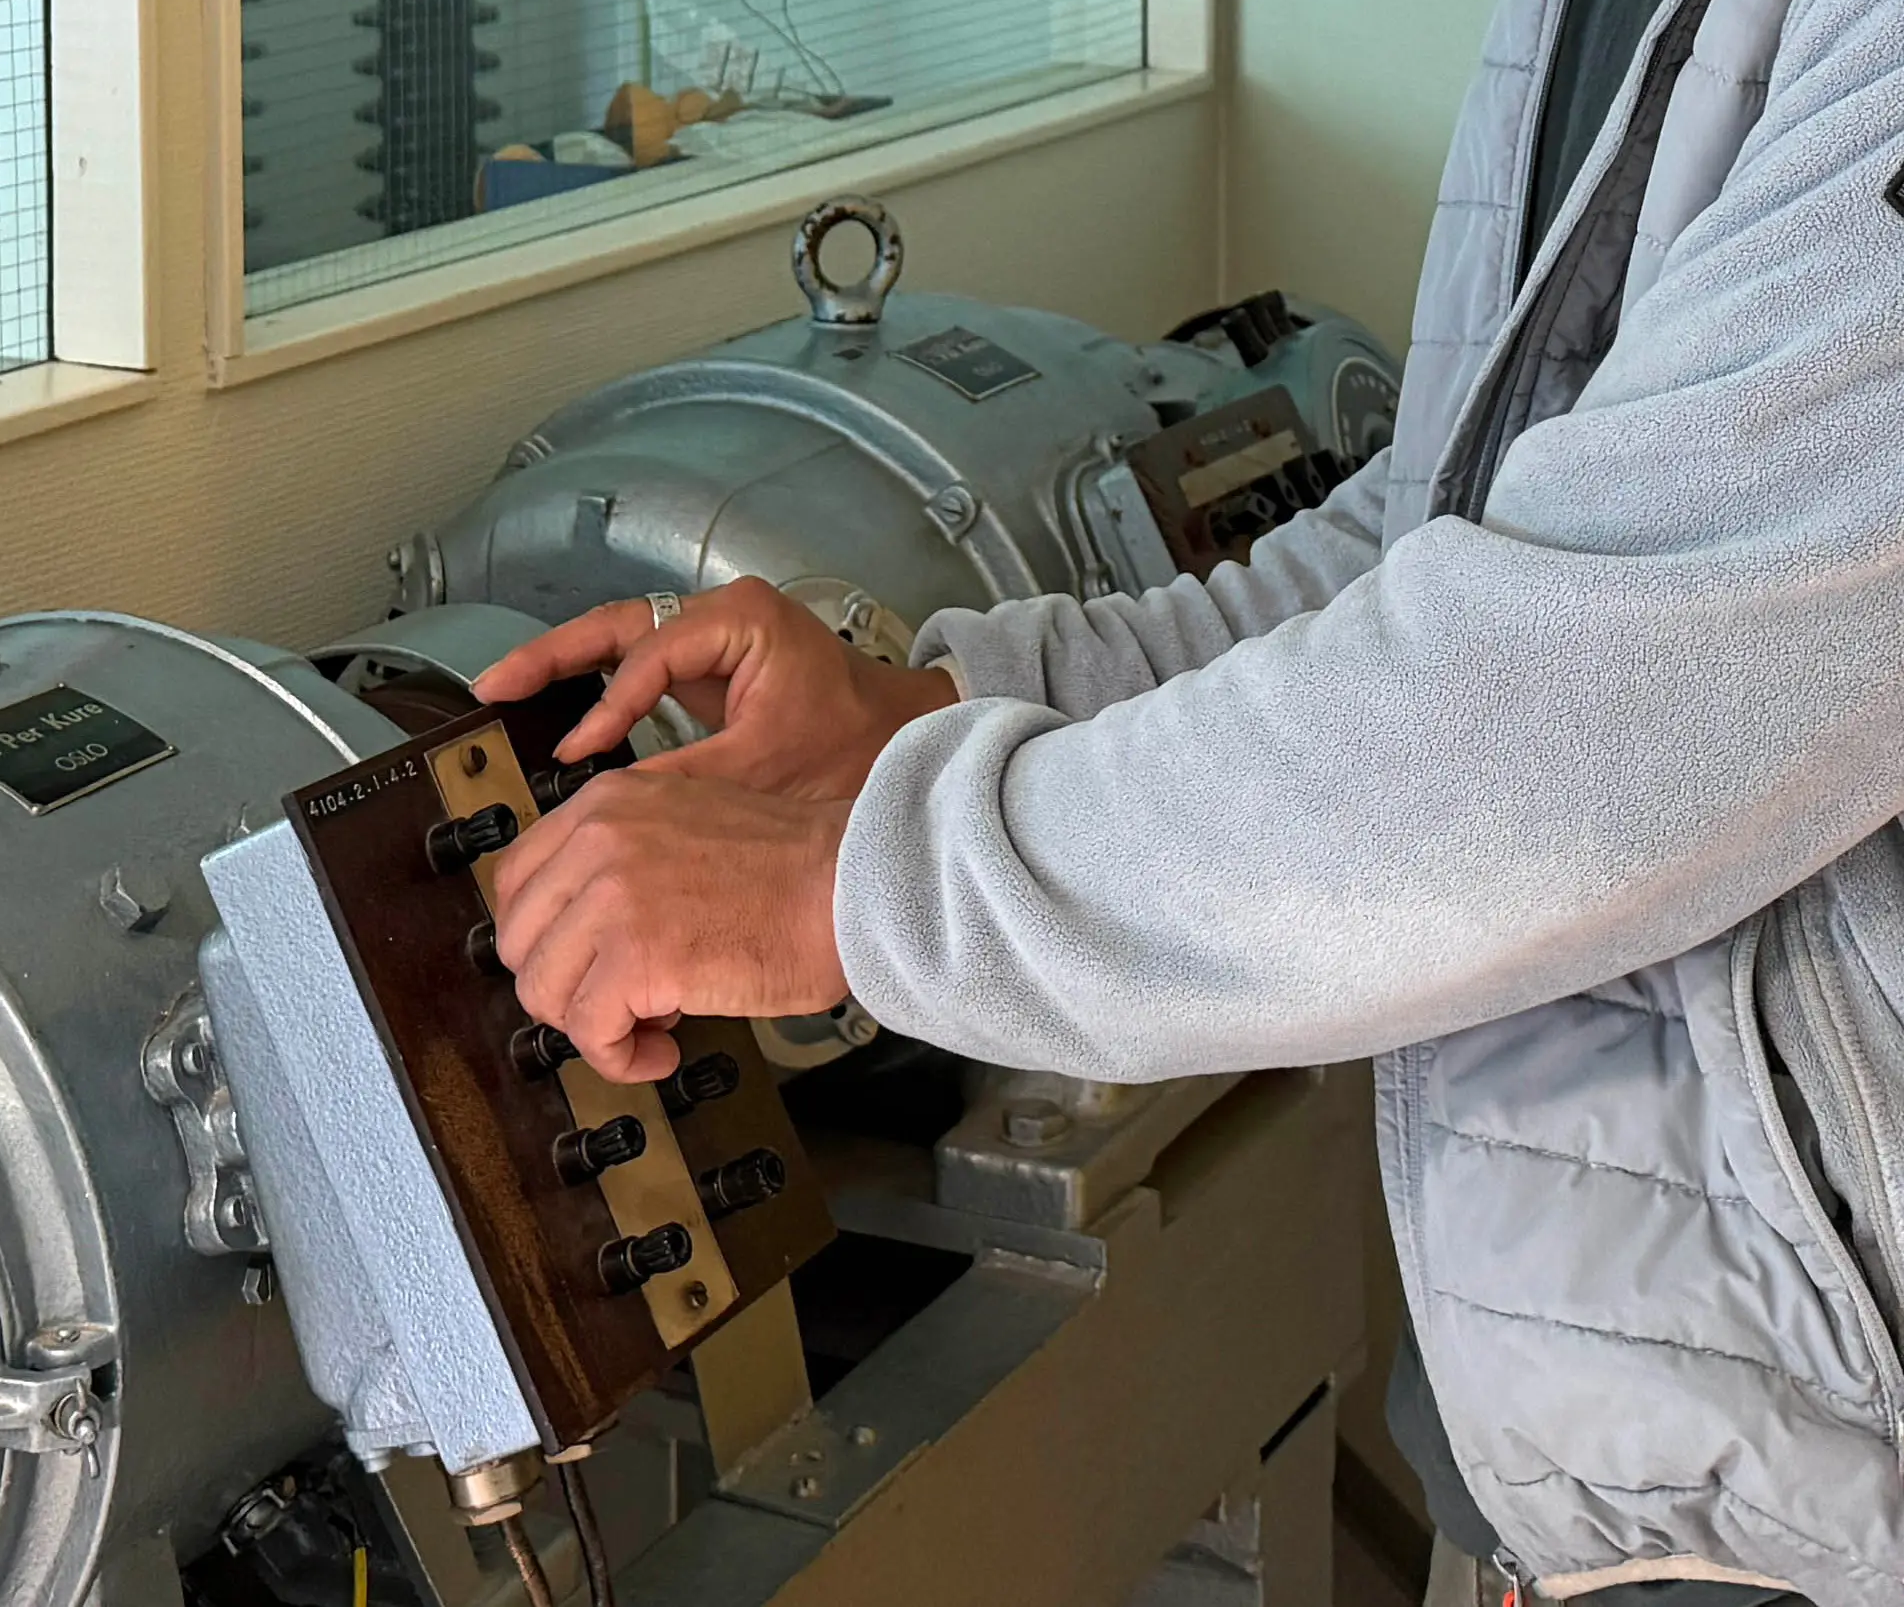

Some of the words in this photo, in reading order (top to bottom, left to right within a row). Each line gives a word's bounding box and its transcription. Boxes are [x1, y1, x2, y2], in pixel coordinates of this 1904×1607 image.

[39, 702, 104, 731] Kure
[54, 743, 109, 772] OSLO
[309, 760, 417, 816] 4104.2.1.4.2
